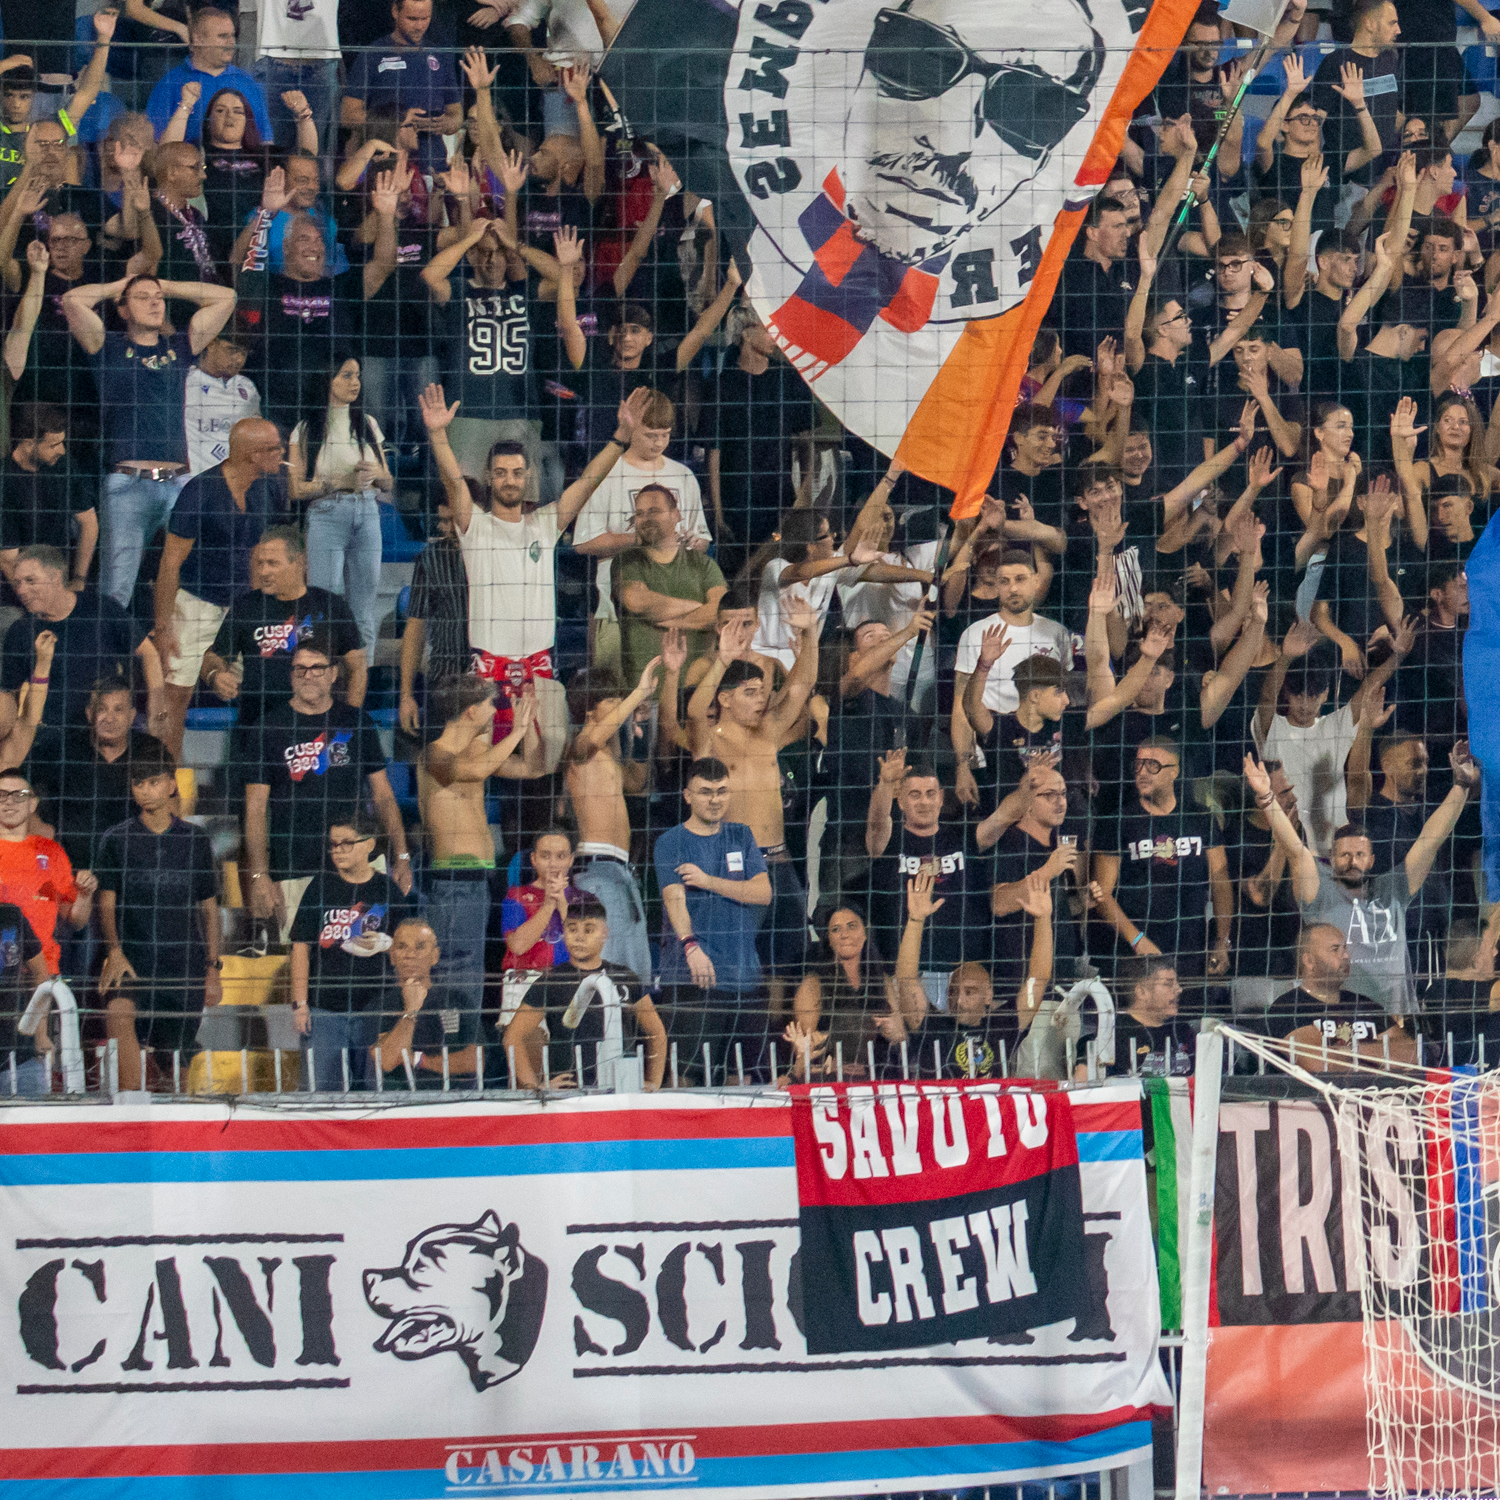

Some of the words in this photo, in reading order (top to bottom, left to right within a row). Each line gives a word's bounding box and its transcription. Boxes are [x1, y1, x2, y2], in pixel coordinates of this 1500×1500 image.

[468, 317, 529, 374] 95
[853, 1199, 1039, 1326] CREW
[18, 1255, 342, 1373] CANI
[444, 1436, 697, 1486] CASARANO
